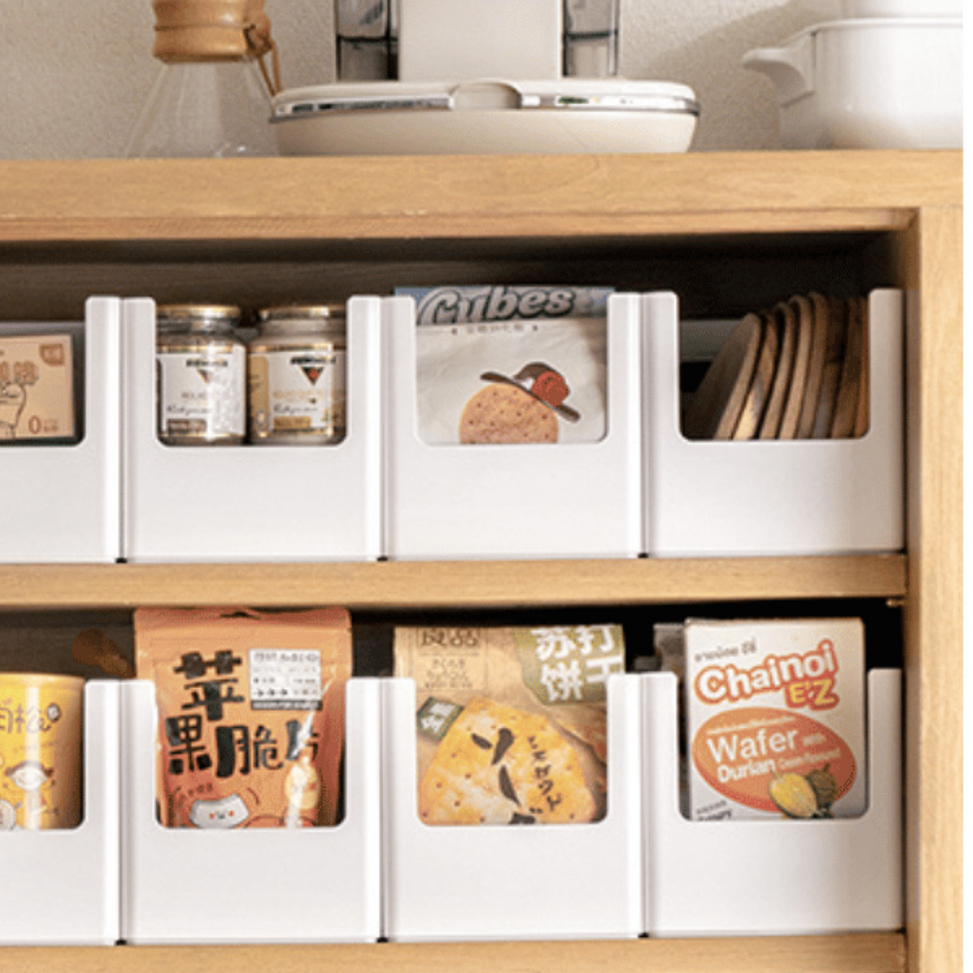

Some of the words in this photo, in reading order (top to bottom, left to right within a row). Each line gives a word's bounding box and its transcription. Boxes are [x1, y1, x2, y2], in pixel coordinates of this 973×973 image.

[417, 286, 576, 324] Cubes
[531, 625, 614, 661] 苏打
[698, 642, 835, 700] Chainoi
[707, 729, 798, 763] Wafer
